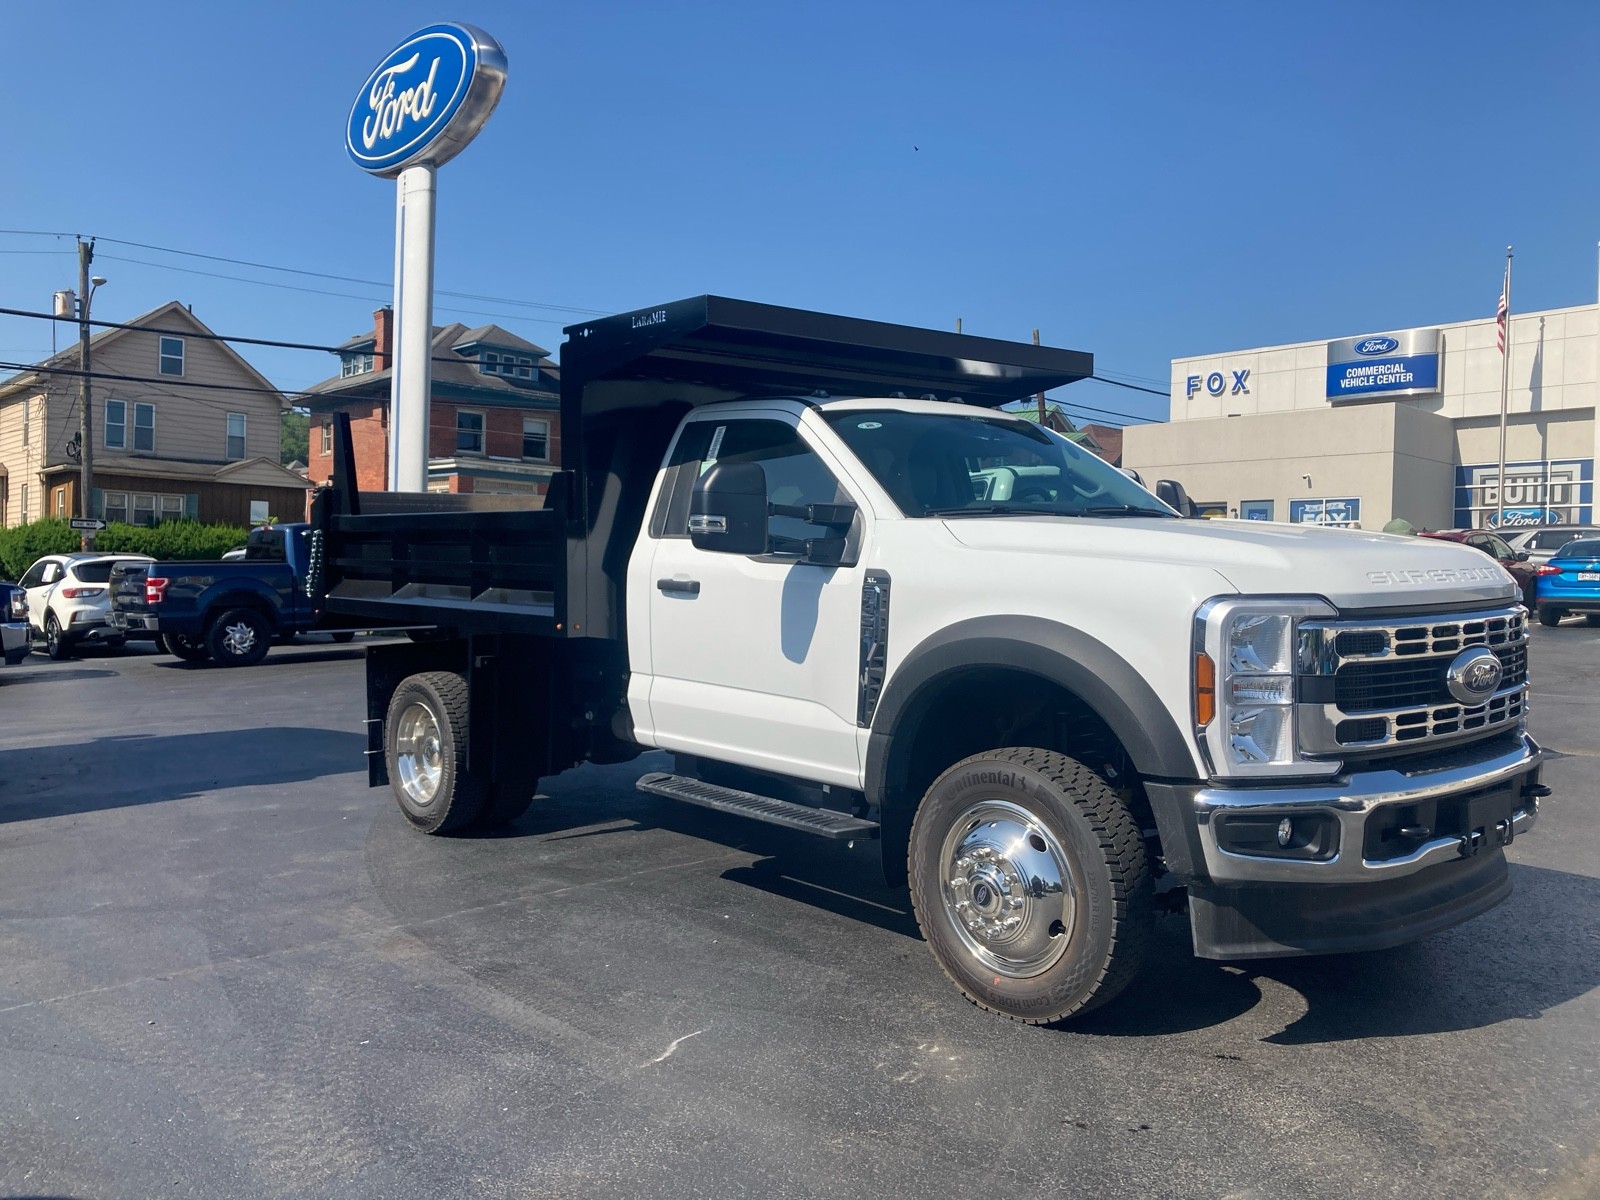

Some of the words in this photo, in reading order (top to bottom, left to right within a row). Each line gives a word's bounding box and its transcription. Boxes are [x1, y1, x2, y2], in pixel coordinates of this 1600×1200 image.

[363, 52, 440, 149] Ford
[1362, 339, 1389, 352] Ford
[1340, 375, 1375, 388] VEHICLE
[1377, 372, 1413, 385] CENTER
[1346, 363, 1406, 378] COMMERCIAL
[1186, 368, 1248, 397] FOX
[1484, 475, 1569, 505] BUILT
[1503, 511, 1544, 527] Ford
[1473, 665, 1496, 687] Ford
[943, 770, 1016, 800] Continental
